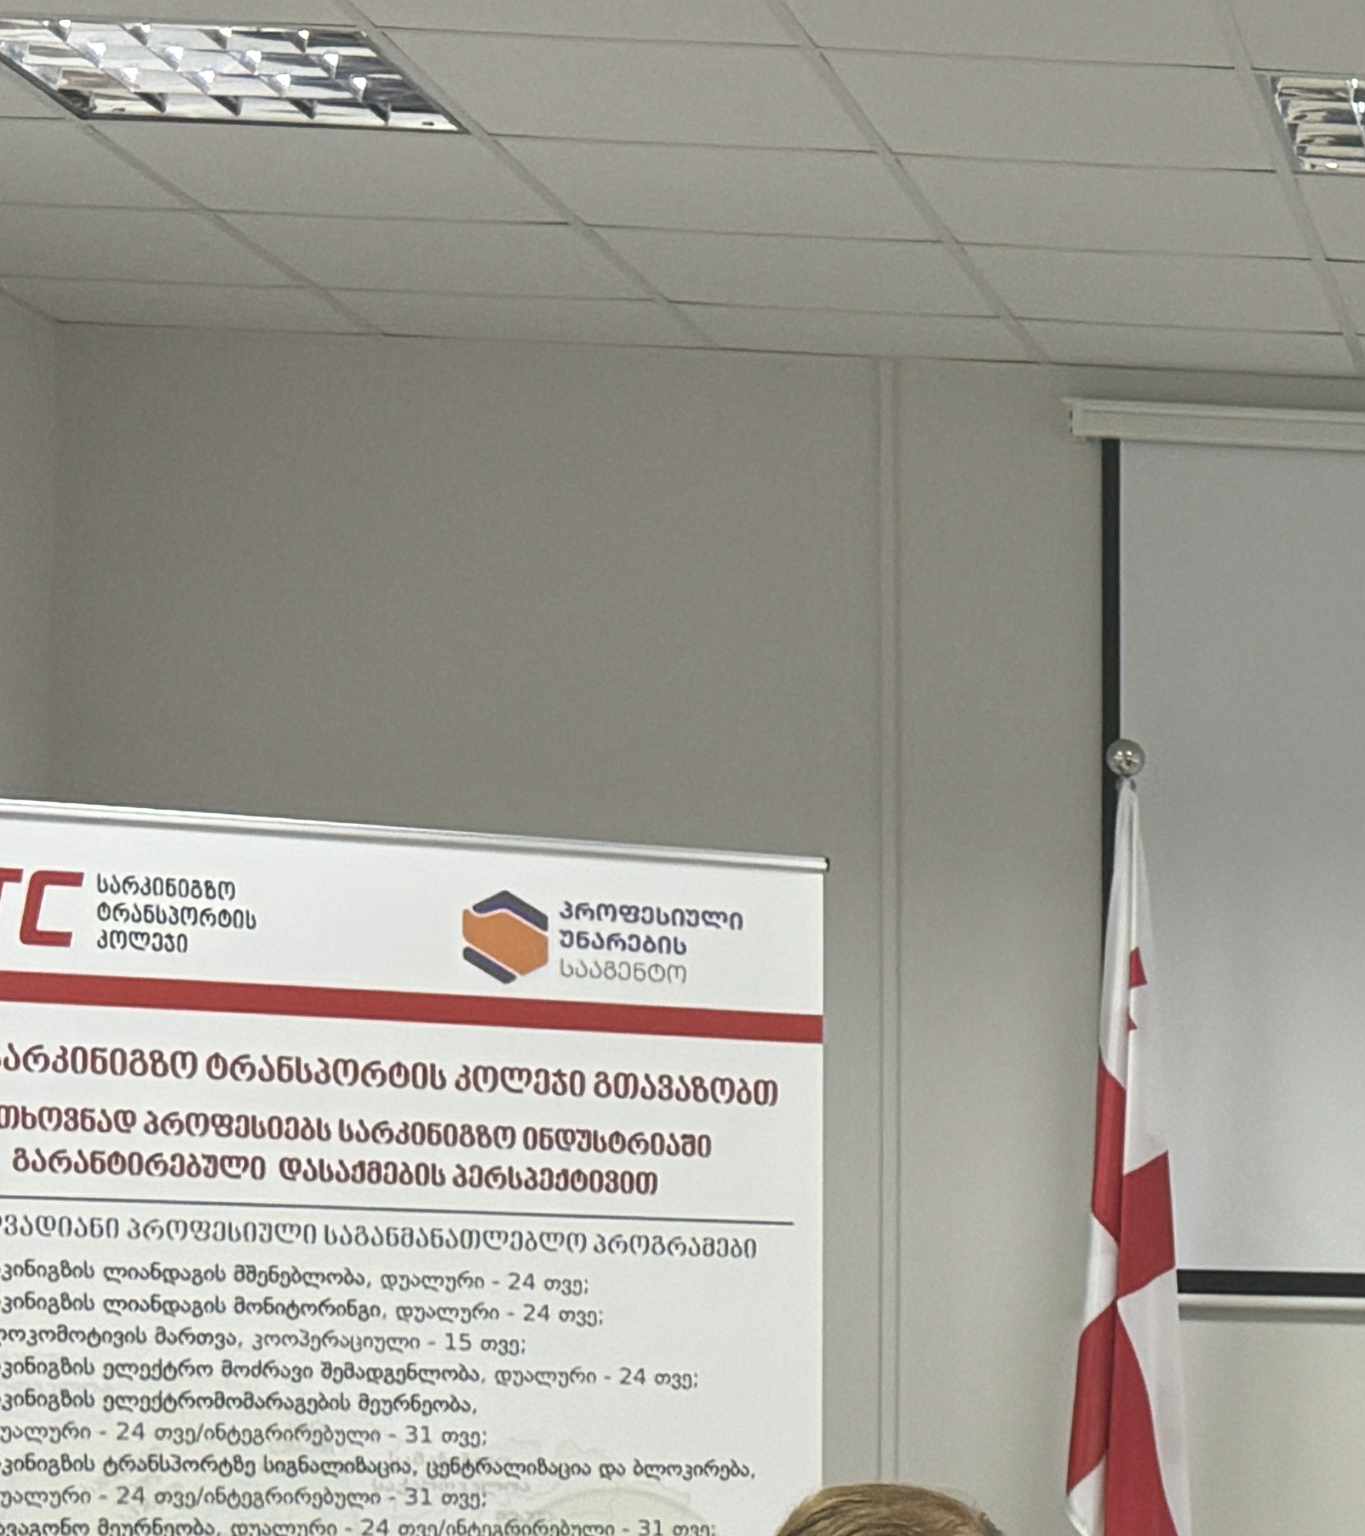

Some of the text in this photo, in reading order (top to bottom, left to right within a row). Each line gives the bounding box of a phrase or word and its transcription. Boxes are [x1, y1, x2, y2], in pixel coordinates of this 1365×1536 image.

[96, 873, 237, 900] სარკინიგზო
[96, 901, 257, 931] ტრანსპორტის
[558, 900, 744, 931] პროფესიული
[96, 928, 188, 954] კოლეჯი
[558, 928, 688, 956] უნარების
[559, 957, 688, 985] სააგენტო
[0, 1042, 779, 1107] არკინიგზო ტრანსპორტის კოლეჯი გთავაზობთ
[142, 1109, 332, 1143] პროფესიებს
[337, 1117, 517, 1150] სარკინიგზო
[522, 1126, 712, 1159] ინდუსტრიაში
[12, 1146, 659, 1196] გარანტირებული დასაქმების პერსპექტივით
[0, 1213, 757, 1259] ვადიანი პროფესიული საგანმანათლებლო პროგრამები
[0, 1257, 96, 1284] კინიგზის
[102, 1260, 227, 1287] ლიანდაგის
[379, 1269, 485, 1294] დუალური
[507, 1271, 536, 1291] 24
[0, 1290, 96, 1316] კინიგზის
[102, 1292, 227, 1319] ლიანდაგის
[395, 1301, 500, 1325] დუალური
[523, 1302, 551, 1323] 24
[251, 1328, 421, 1355] კოოპერაციული
[445, 1332, 473, 1352] 15
[0, 1354, 96, 1381] კინიგზის
[101, 1357, 214, 1382] ელექტრო
[220, 1358, 314, 1384] მოძრავი
[493, 1365, 597, 1389] დუალური
[619, 1366, 646, 1386] 24
[0, 1387, 96, 1413] კინიგზის
[102, 1389, 352, 1416] ელექტრომომარაგების
[115, 1420, 146, 1442] 24
[153, 1421, 382, 1448] თვე/ინტეგრირებული
[404, 1424, 433, 1445] 31
[0, 1451, 96, 1478] კინიგზის
[102, 1452, 257, 1479] ტრანსპორტზე
[425, 1455, 592, 1481] ცენტრალიზაცია
[597, 1462, 627, 1481] და
[115, 1485, 147, 1506] 24
[153, 1484, 382, 1511] თვე/ინტეგრირებული
[404, 1485, 433, 1507] 31
